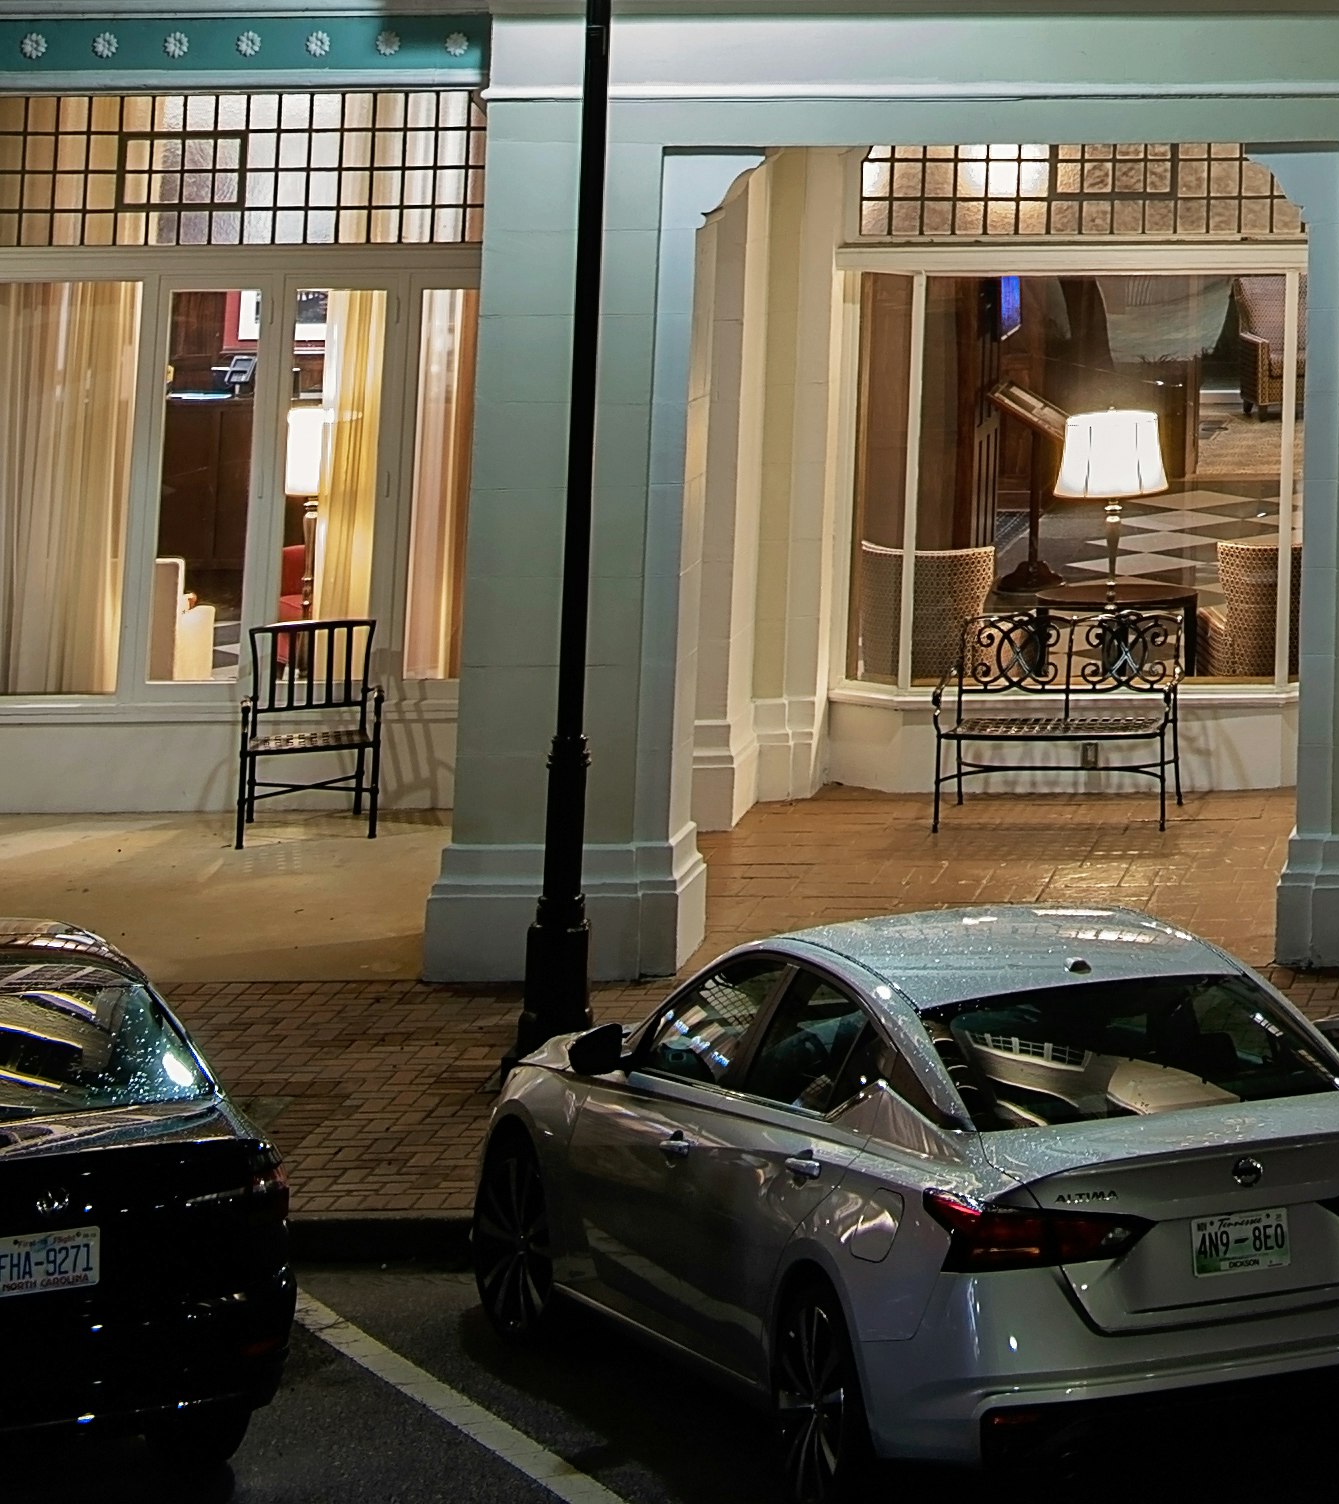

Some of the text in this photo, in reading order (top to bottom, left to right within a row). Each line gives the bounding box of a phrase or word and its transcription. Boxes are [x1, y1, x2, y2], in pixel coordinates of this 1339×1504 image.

[1055, 1190, 1119, 1205] ALTIMA
[1217, 1217, 1263, 1231] Tennessee
[1228, 1259, 1260, 1268] DICKSON
[3, 1271, 89, 1292] NORTH CAROLINA
